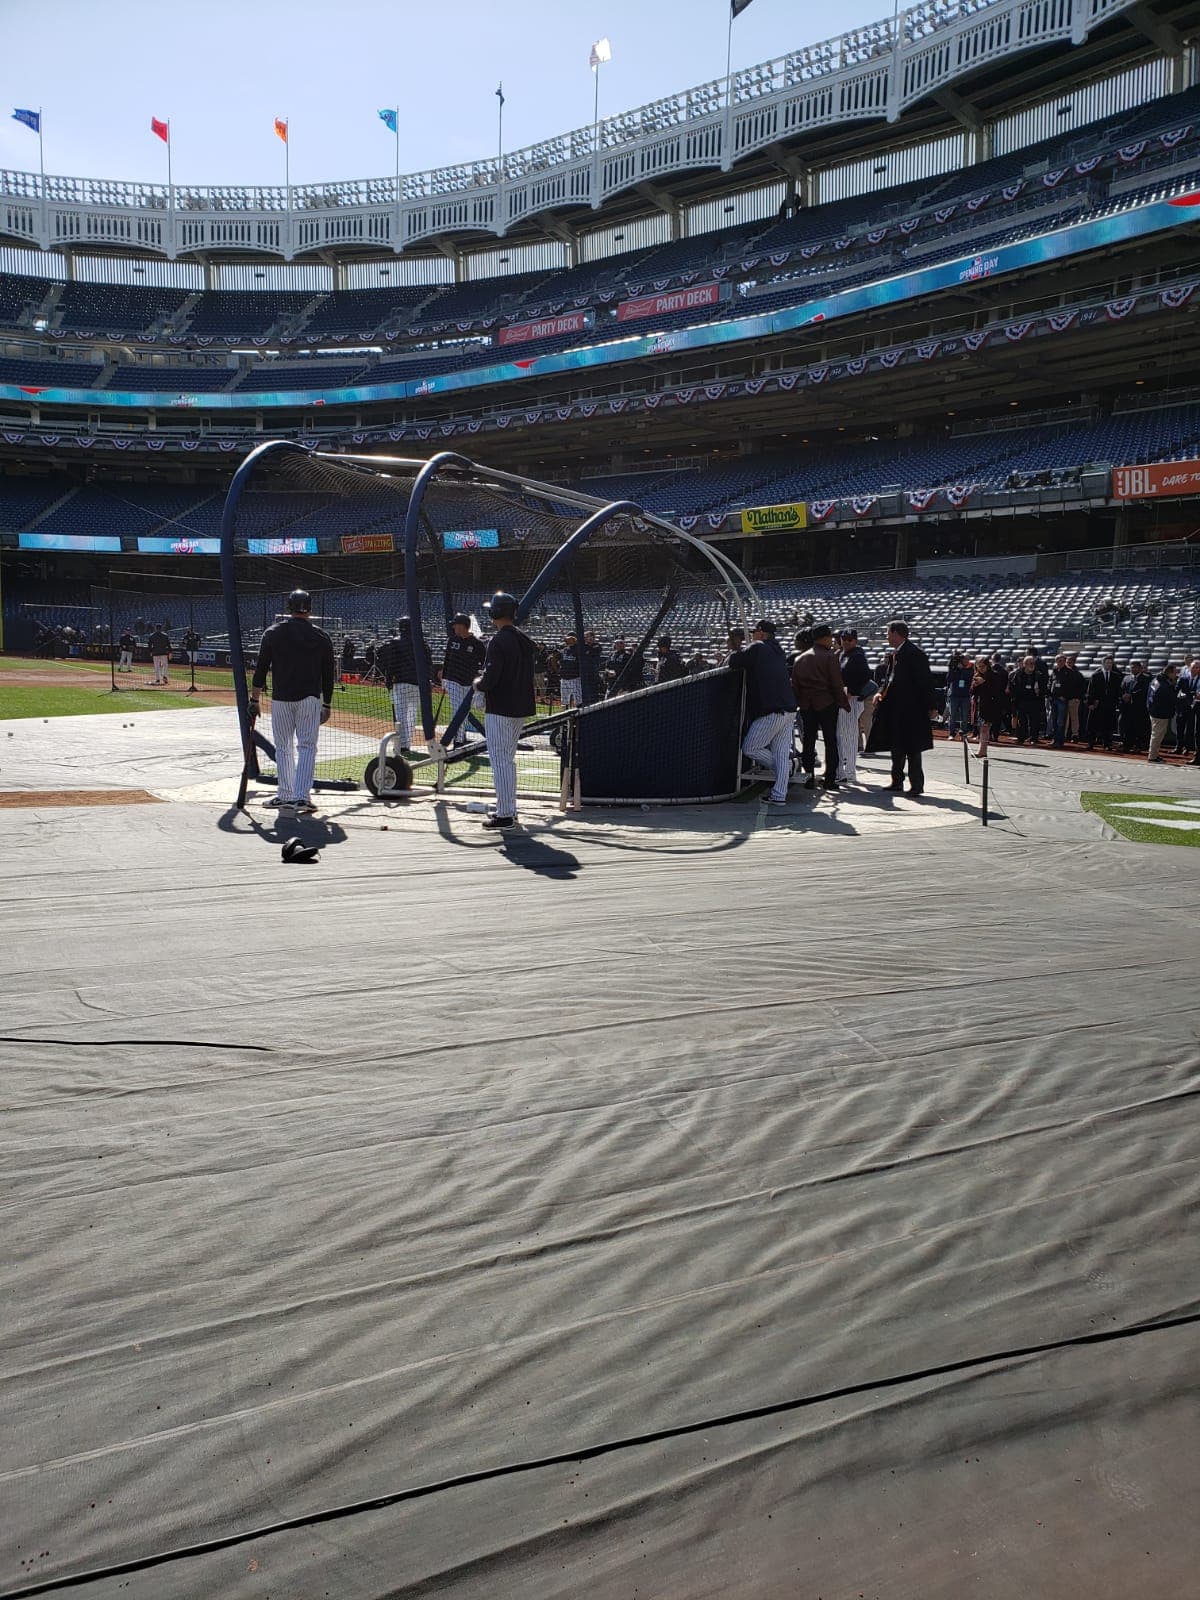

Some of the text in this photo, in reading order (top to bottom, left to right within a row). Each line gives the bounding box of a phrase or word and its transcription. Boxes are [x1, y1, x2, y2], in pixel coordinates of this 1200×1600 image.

[984, 256, 999, 271] DAY
[656, 293, 686, 312] PARTY
[687, 288, 713, 305] DECK
[531, 322, 556, 337] PARTY
[557, 316, 579, 332] DECK
[1117, 469, 1157, 496] JBL
[1162, 473, 1188, 487] DARE
[747, 507, 799, 526] Nathan's
